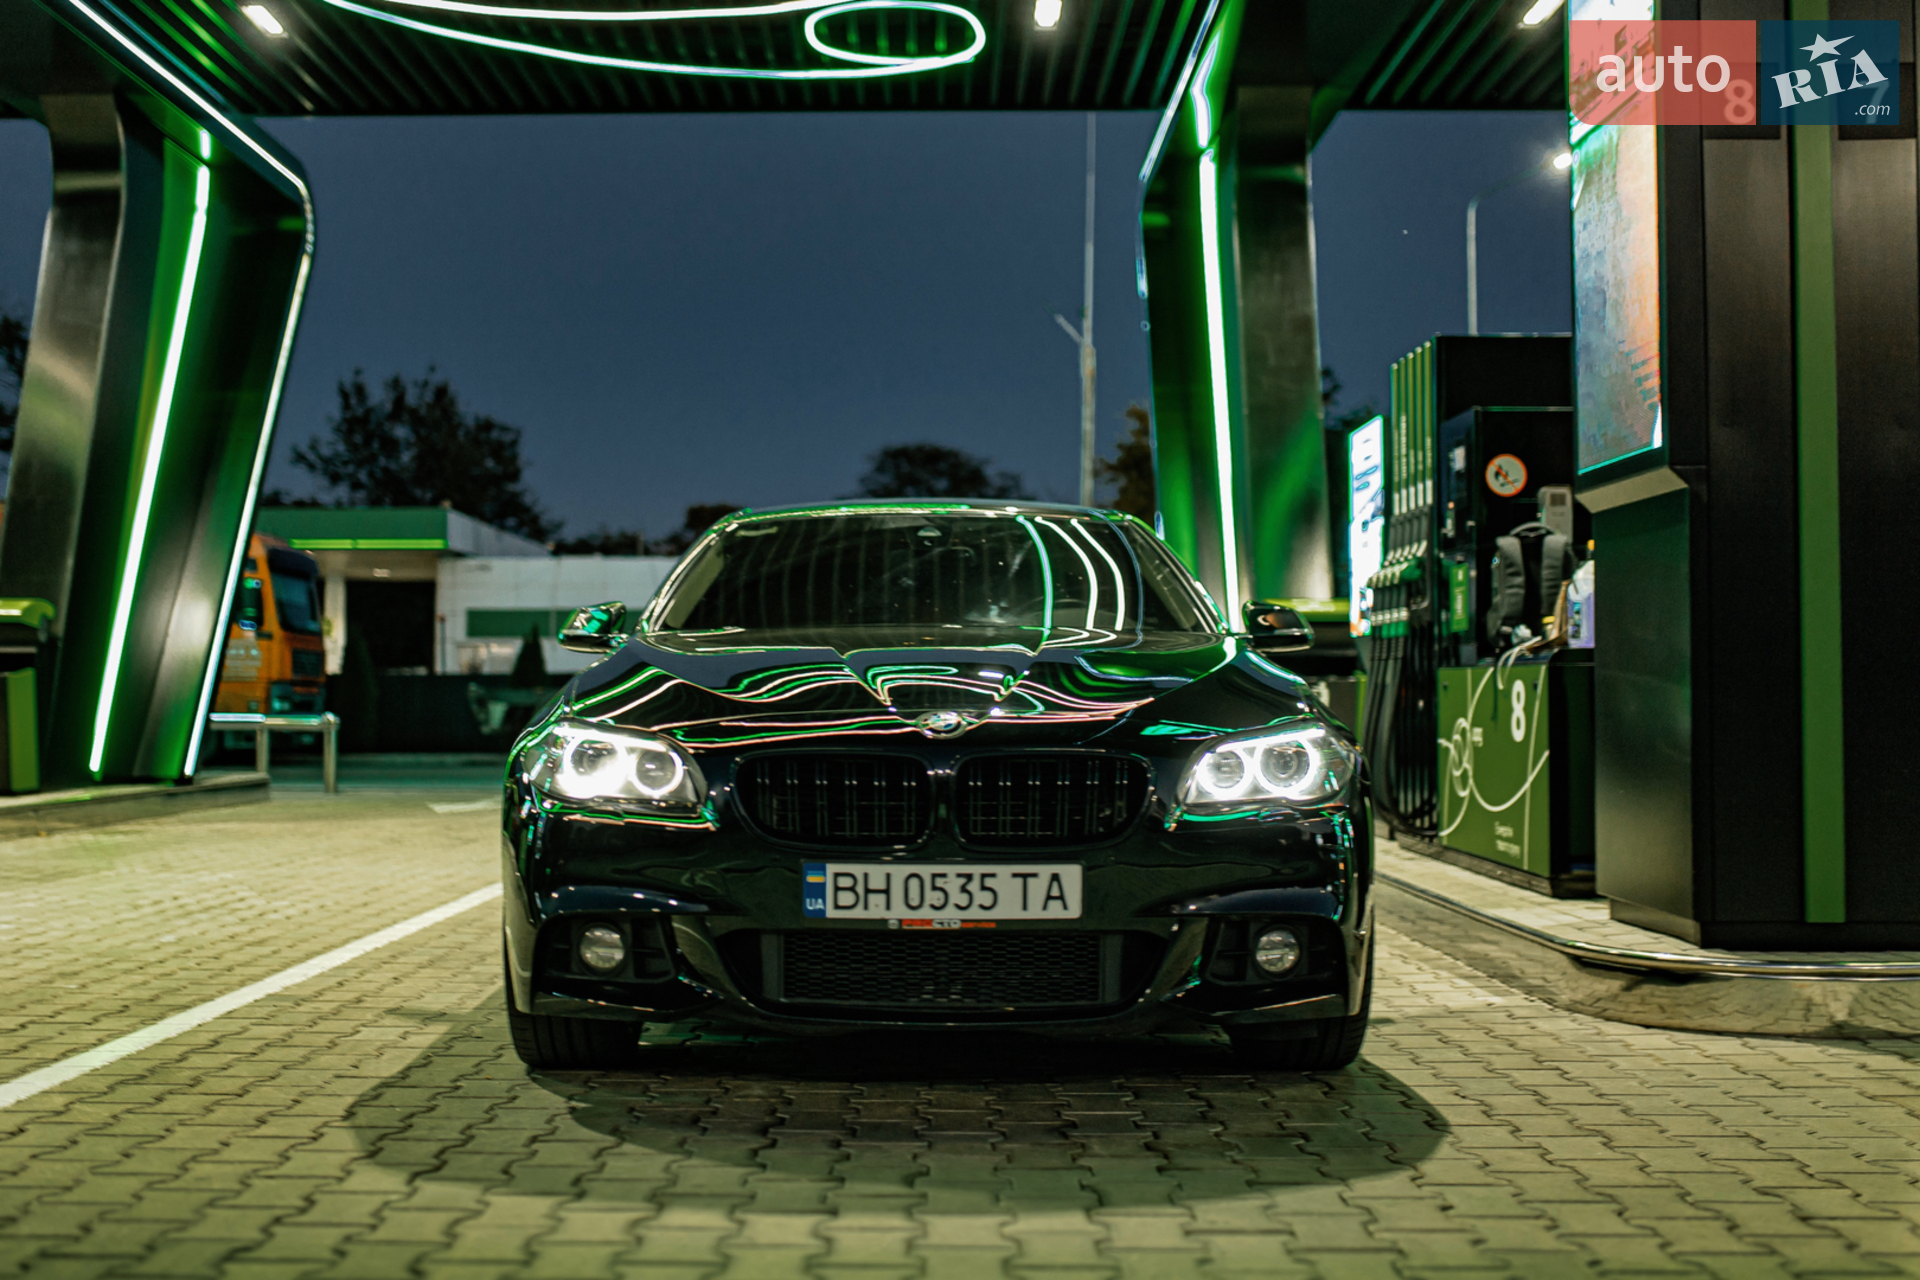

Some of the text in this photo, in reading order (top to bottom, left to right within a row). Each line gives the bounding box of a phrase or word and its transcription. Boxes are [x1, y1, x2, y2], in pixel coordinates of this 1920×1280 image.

[1723, 79, 1755, 125] 8
[1511, 679, 1526, 743] 8
[805, 898, 826, 911] UA
[832, 871, 1069, 912] BH 0535 TA
